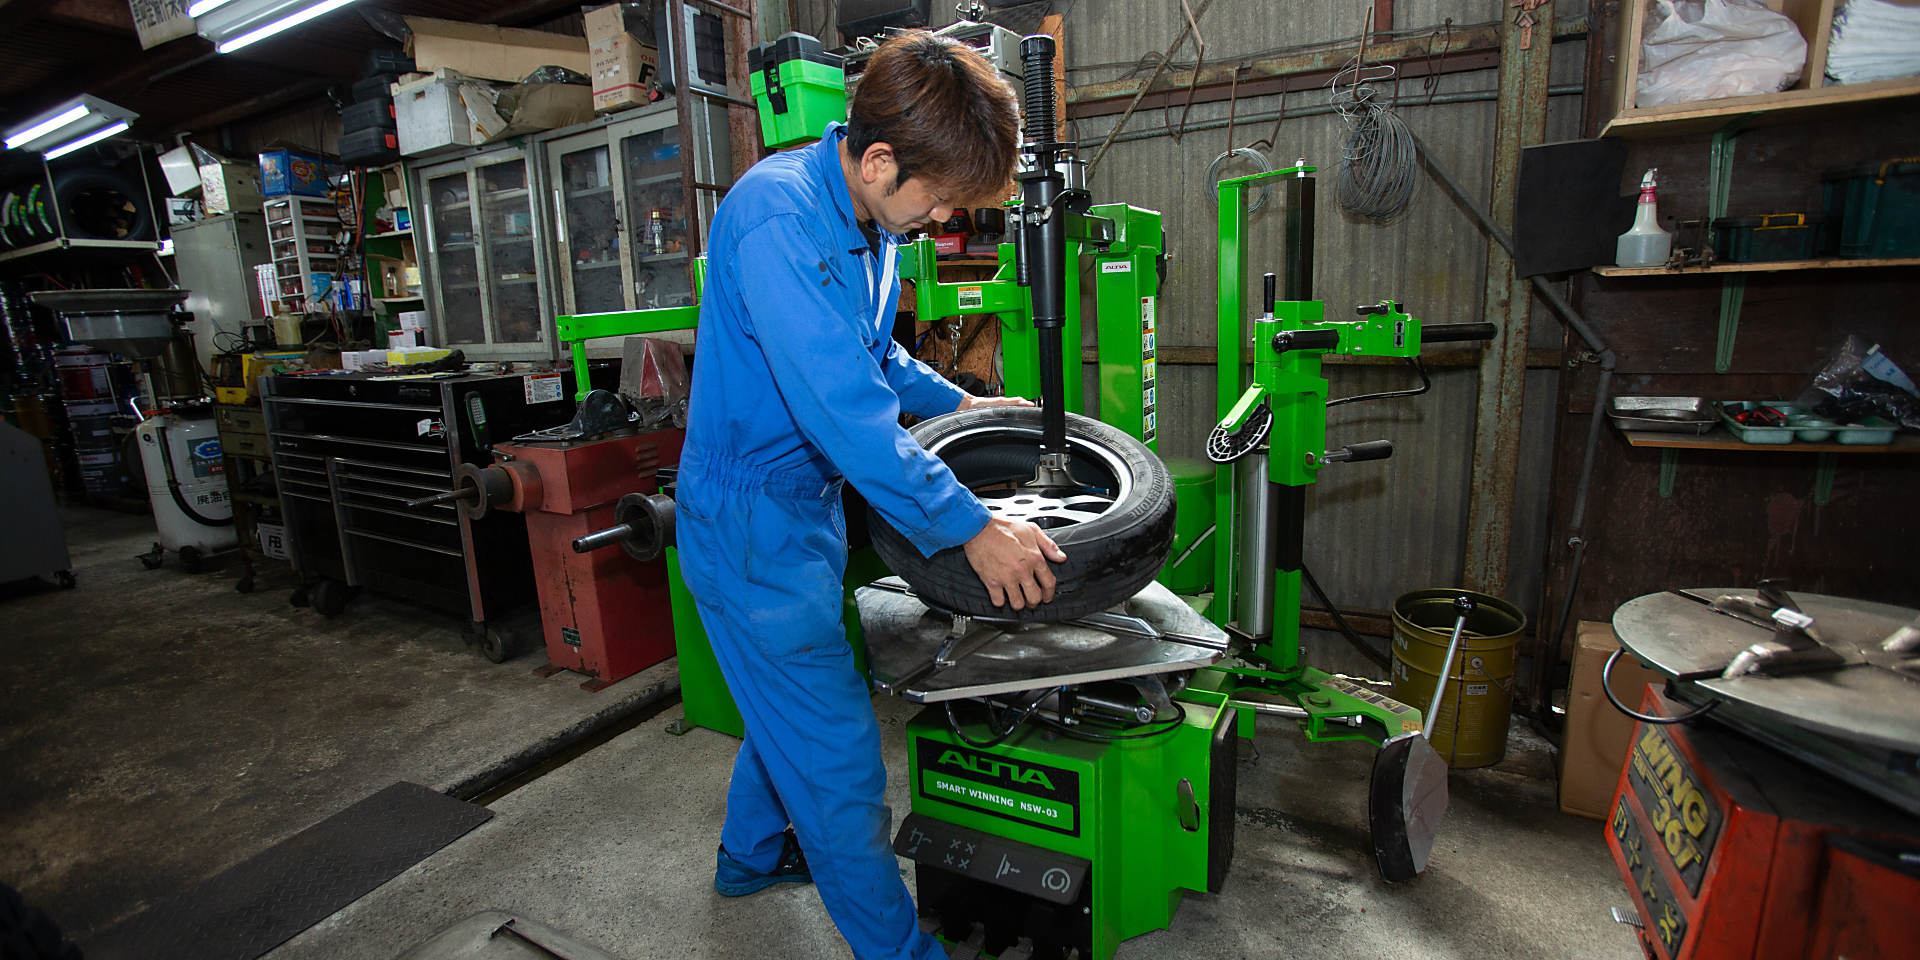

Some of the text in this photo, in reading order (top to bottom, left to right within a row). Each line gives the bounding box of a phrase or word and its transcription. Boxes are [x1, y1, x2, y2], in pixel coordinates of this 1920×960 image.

[937, 750, 1056, 791] ALTIA
[1640, 723, 1709, 838] WING
[936, 780, 1058, 818] SMART WINNING NSW-03
